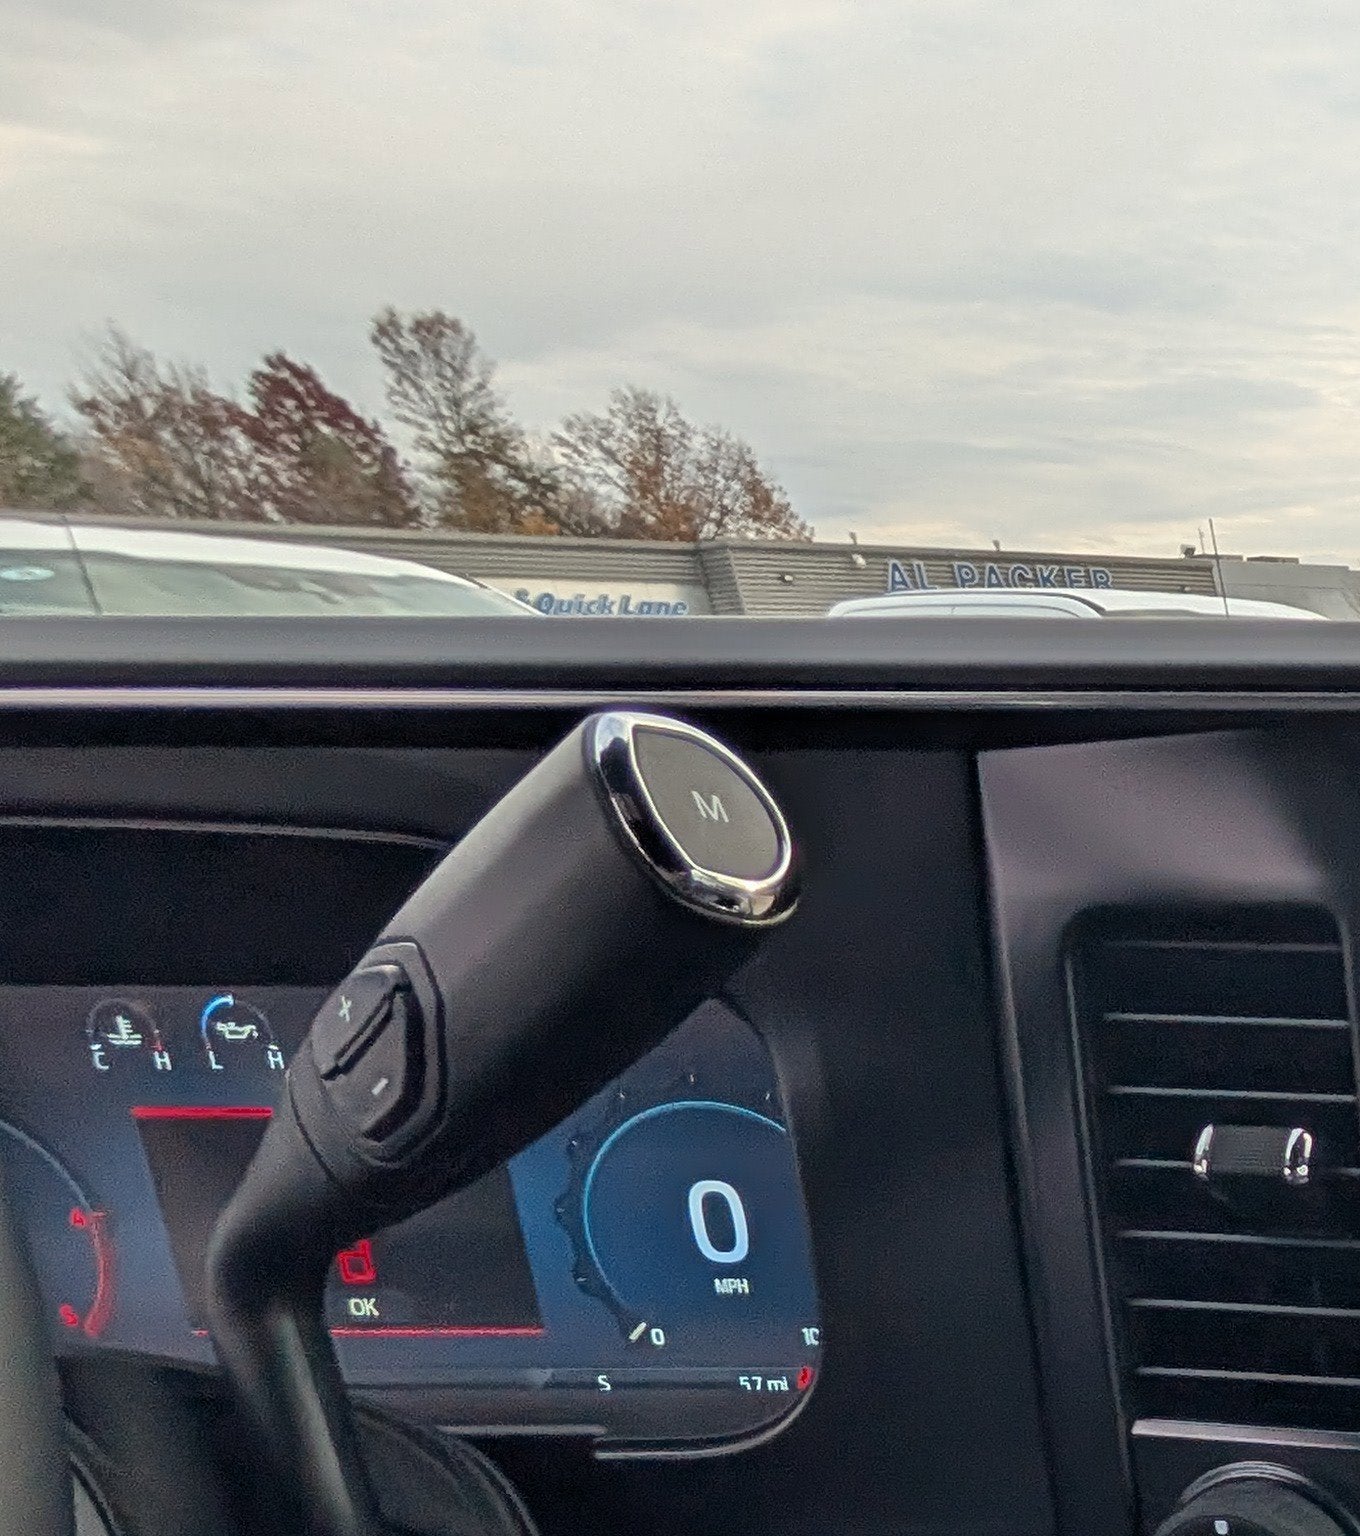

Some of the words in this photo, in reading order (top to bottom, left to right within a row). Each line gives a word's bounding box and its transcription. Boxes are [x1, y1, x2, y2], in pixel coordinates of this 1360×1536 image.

[888, 560, 938, 592] AL
[954, 562, 1113, 589] PACKER
[533, 593, 614, 615] Quick
[618, 595, 688, 615] Lane
[691, 790, 729, 823] M
[154, 1051, 172, 1070] H
[209, 1051, 224, 1070] L
[267, 1051, 285, 1070] H
[689, 1180, 748, 1263] 0
[714, 1278, 749, 1294] MPH
[348, 1297, 380, 1316] OK
[651, 1328, 665, 1346] 0
[739, 1376, 762, 1391] 57
[767, 1377, 789, 1392] mi
